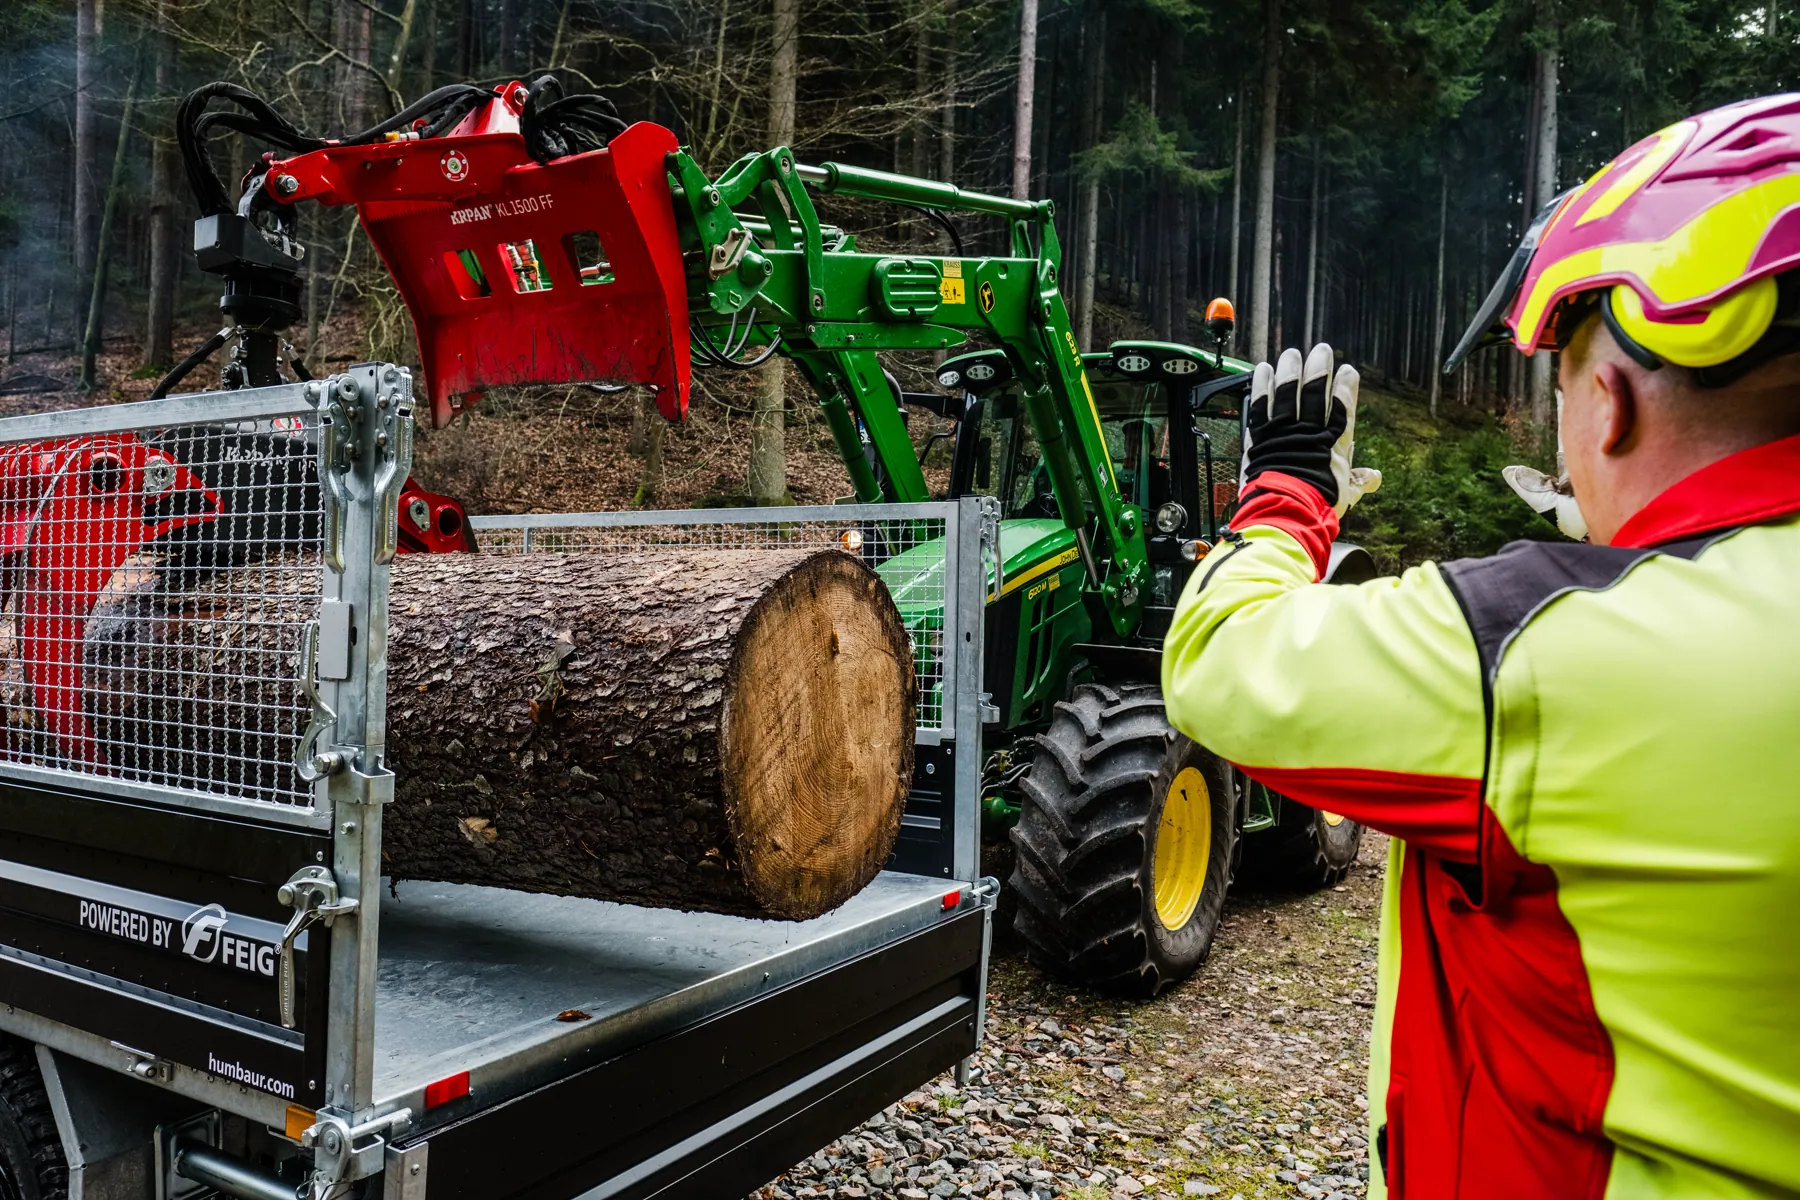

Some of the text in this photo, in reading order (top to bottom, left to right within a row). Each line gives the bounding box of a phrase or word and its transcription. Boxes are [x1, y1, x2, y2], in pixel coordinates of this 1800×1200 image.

[450, 194, 554, 225] KRPAN KL 1500 FF
[1060, 552, 1072, 565] JOHN
[80, 900, 149, 942] POWERED
[153, 919, 173, 948] BY
[208, 1052, 294, 1099] humbaur.com
